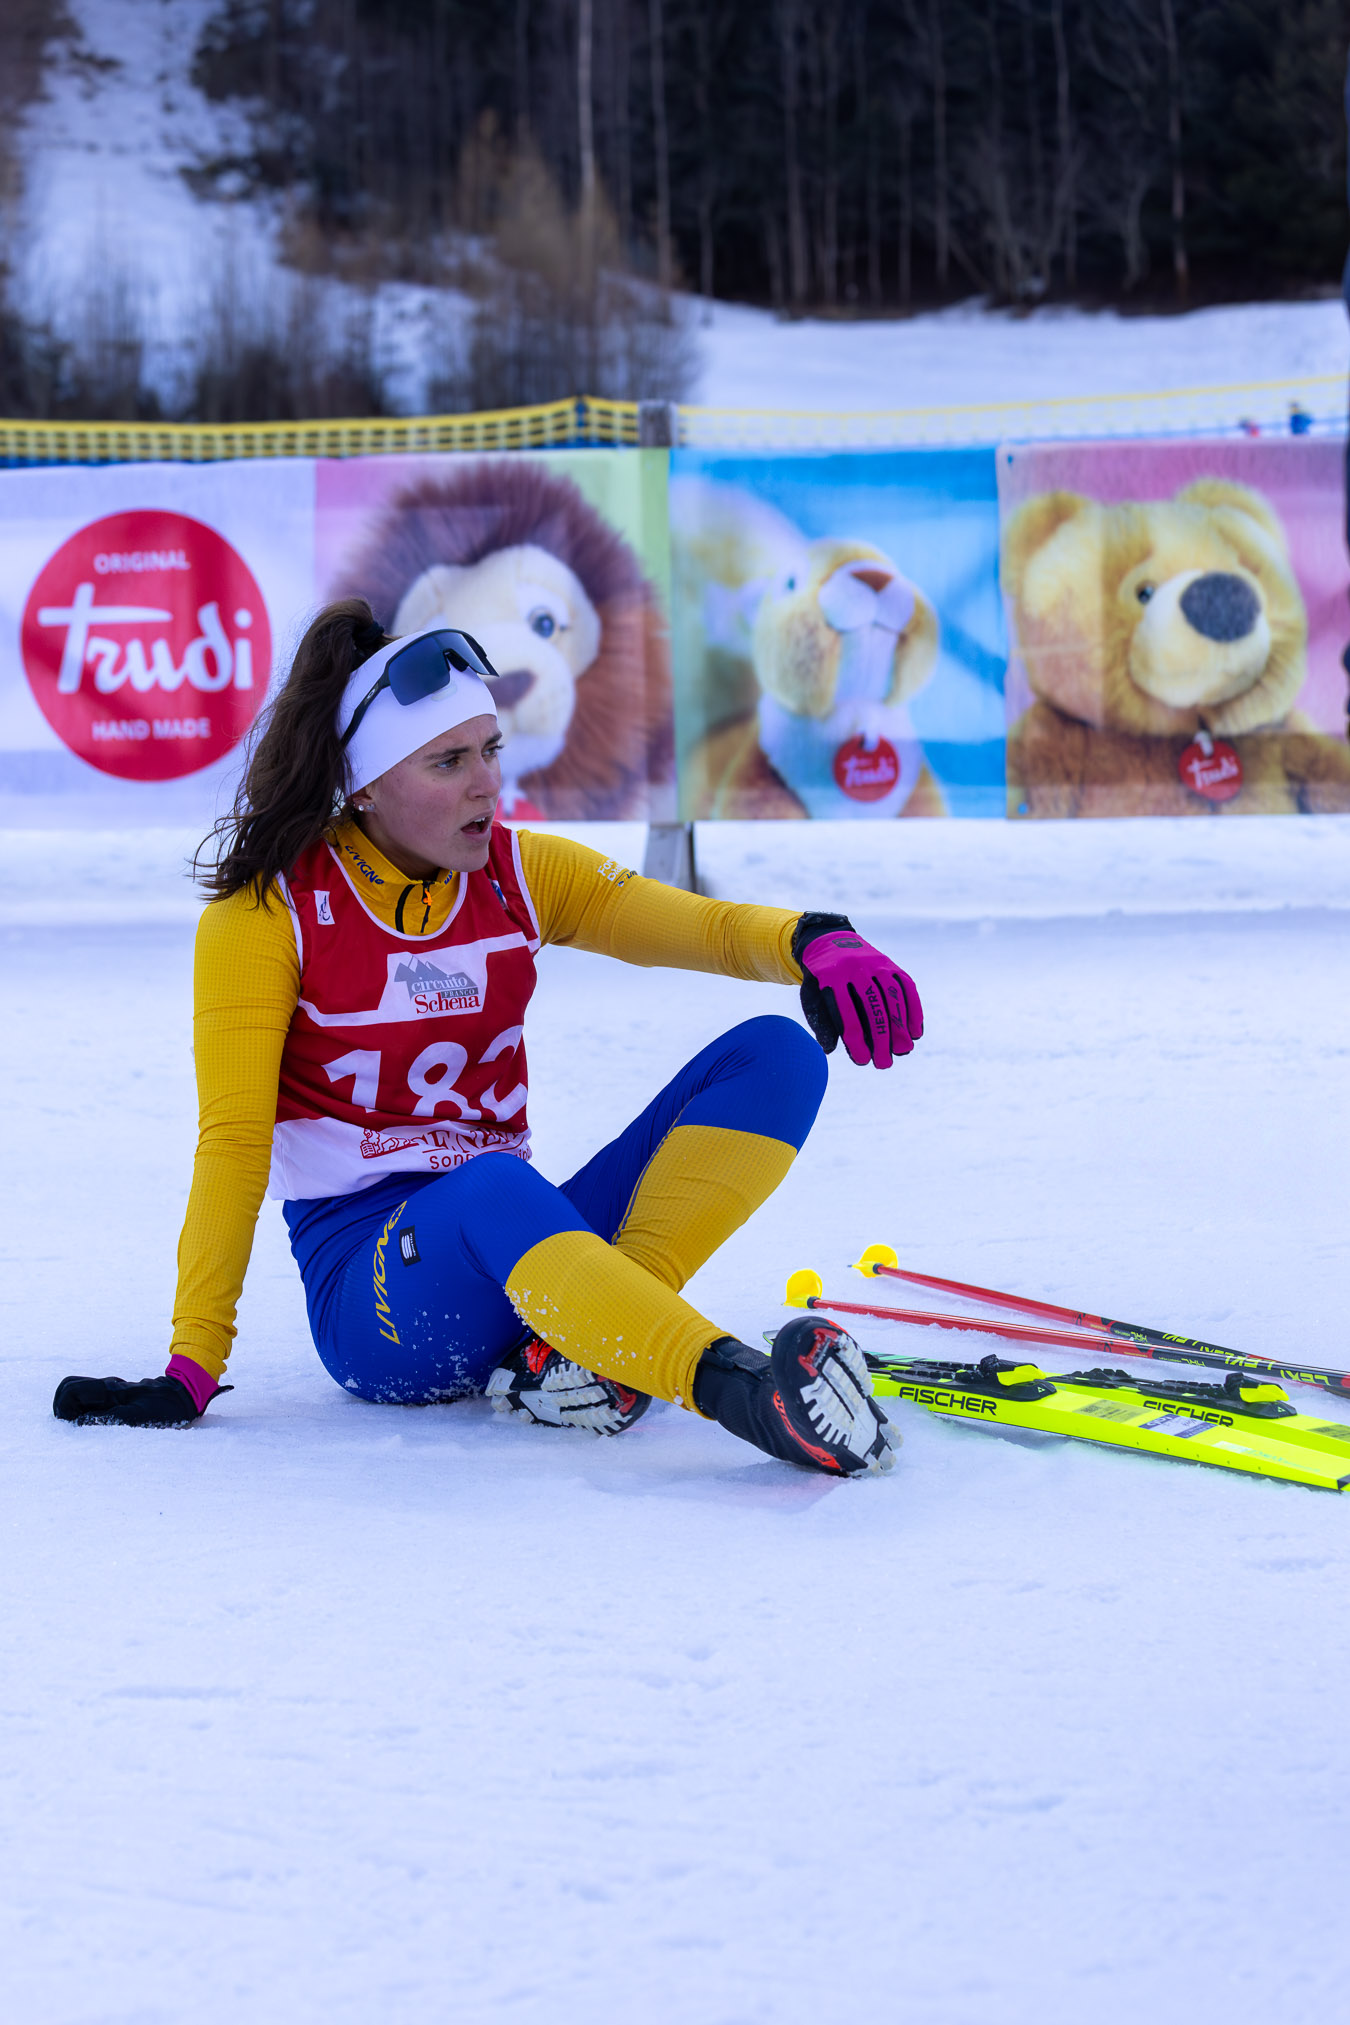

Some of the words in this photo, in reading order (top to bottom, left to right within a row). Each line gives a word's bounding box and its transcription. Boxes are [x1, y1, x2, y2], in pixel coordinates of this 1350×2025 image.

[94, 551, 190, 574] ORIGINAL
[37, 582, 253, 694] Trudi
[92, 719, 150, 740] HAND
[153, 717, 211, 740] MADE
[411, 975, 468, 993] circuito
[444, 988, 475, 998] FRANCO
[414, 992, 481, 1014] Schena
[865, 985, 887, 1035] HESTRA
[1280, 1369, 1332, 1386] LEKI
[899, 1386, 998, 1416] FISCHER
